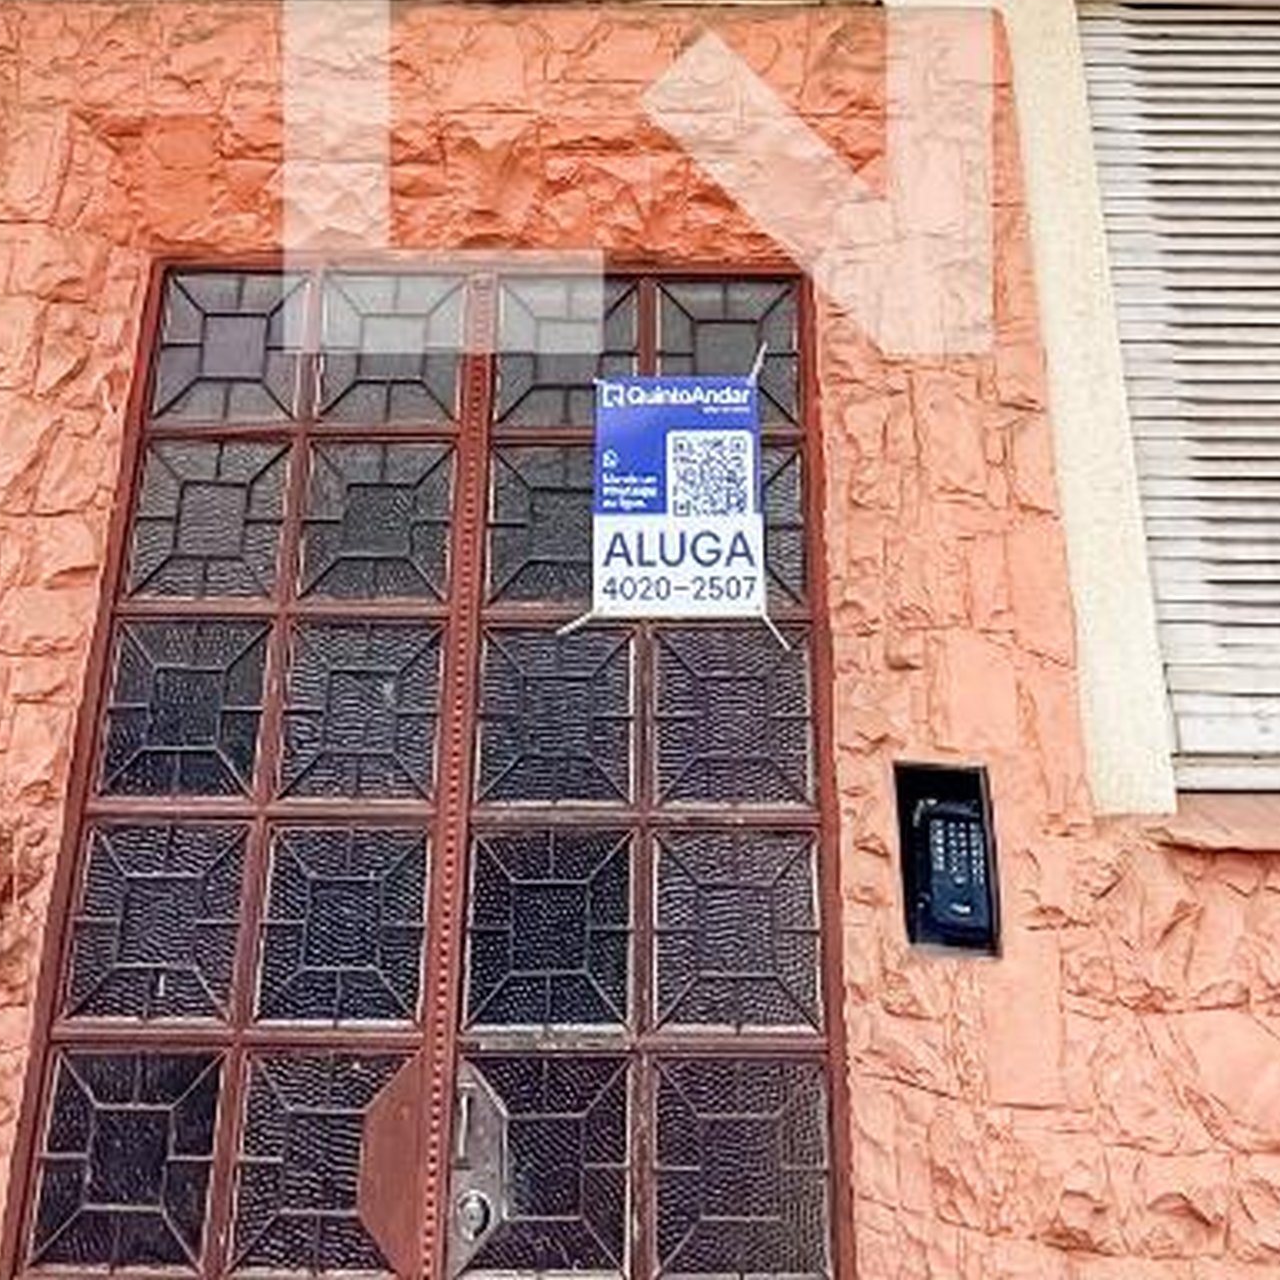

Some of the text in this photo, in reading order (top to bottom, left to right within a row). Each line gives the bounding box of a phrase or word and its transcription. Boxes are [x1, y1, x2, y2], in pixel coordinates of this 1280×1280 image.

[626, 385, 750, 405] QuintoAndar
[601, 530, 756, 568] ALUGA
[601, 576, 757, 601] 4020-2507
